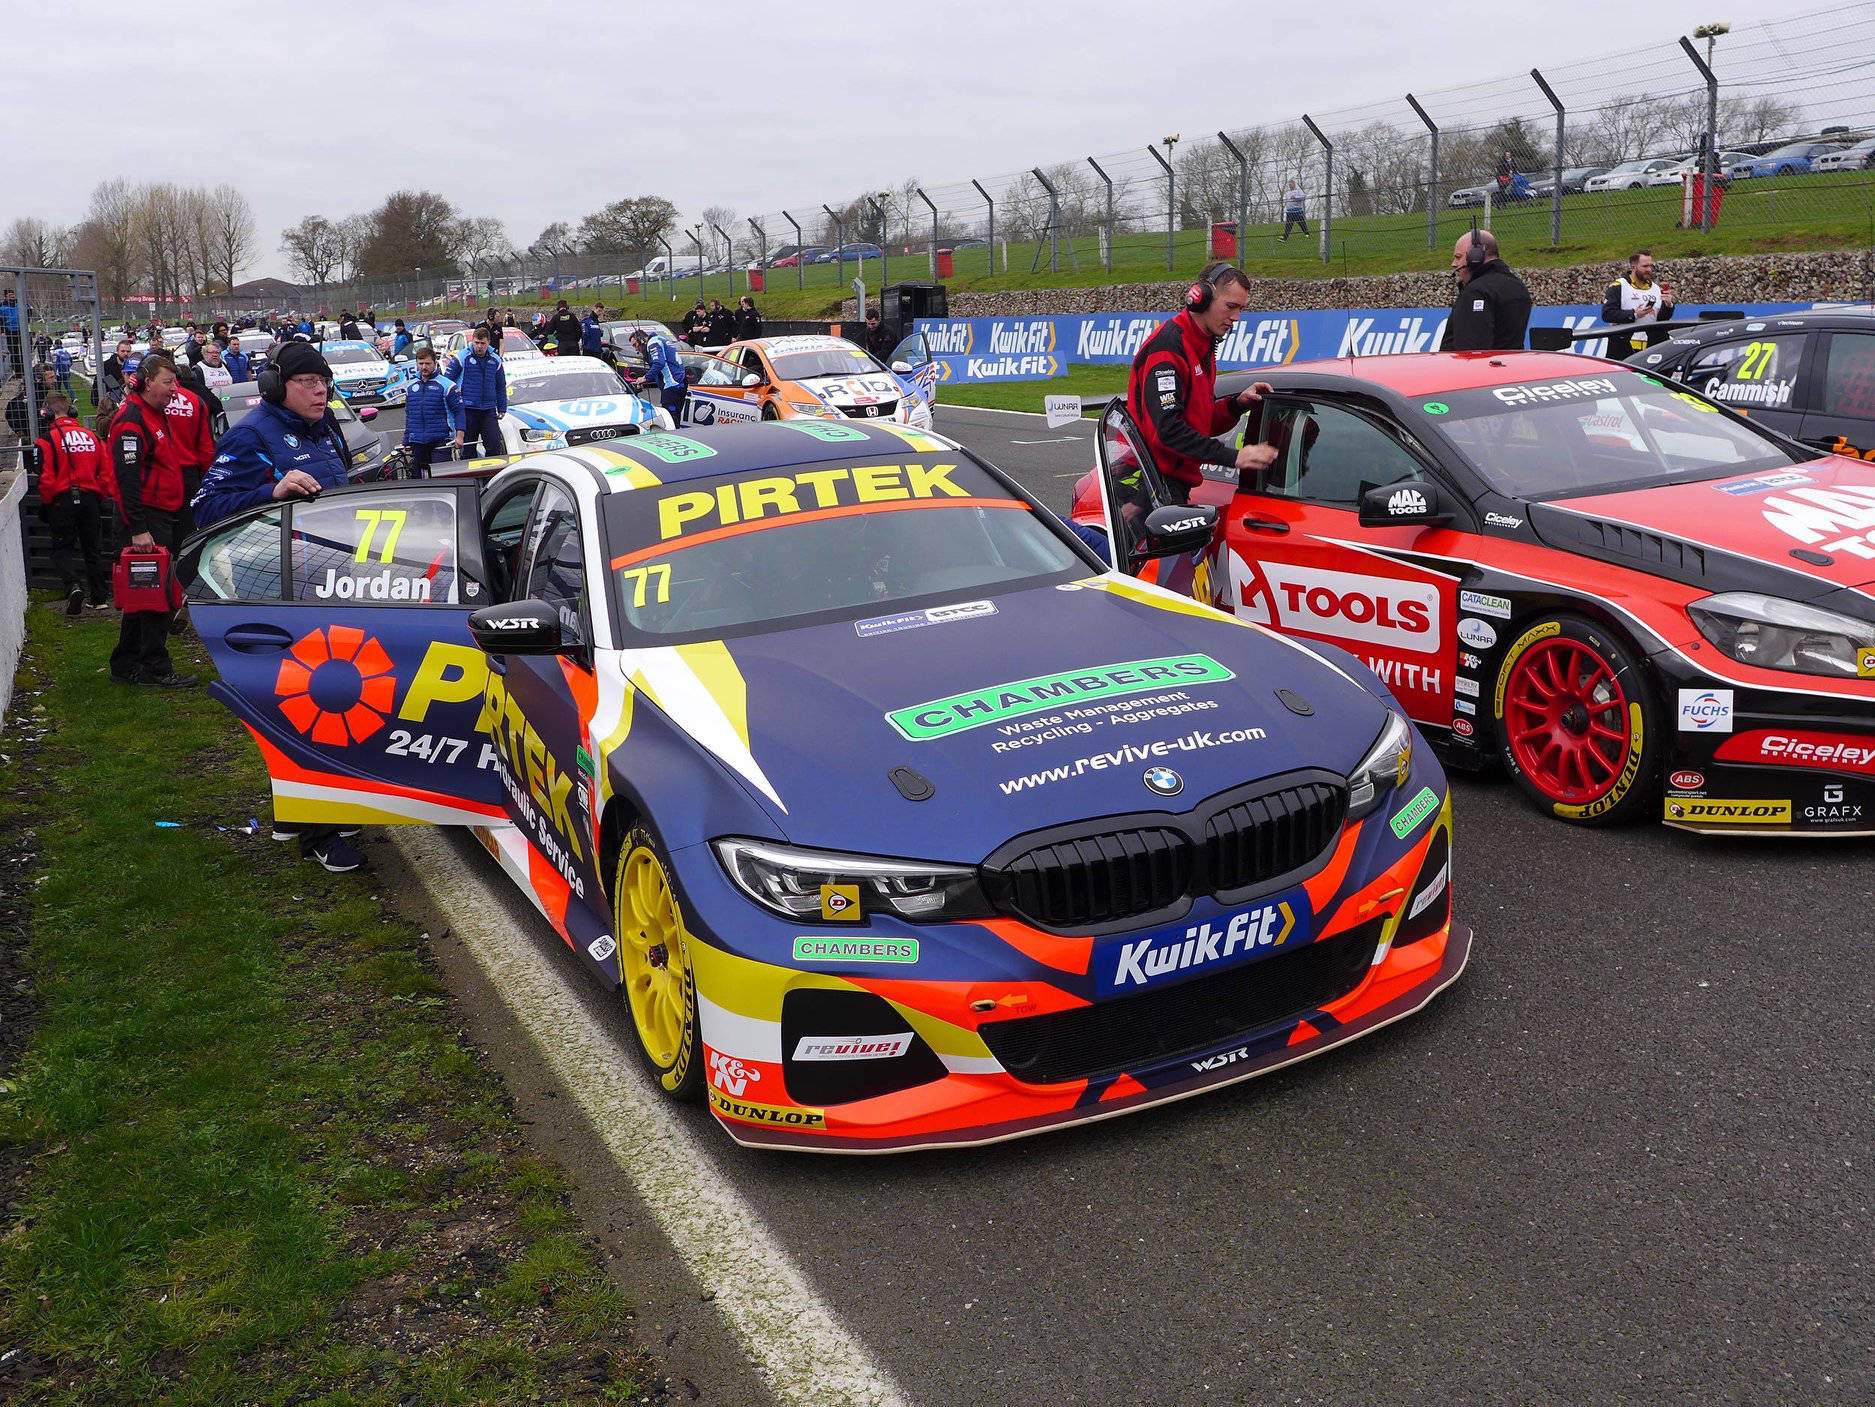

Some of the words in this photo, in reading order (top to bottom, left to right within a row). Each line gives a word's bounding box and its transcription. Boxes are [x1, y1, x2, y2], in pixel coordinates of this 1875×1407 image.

[1737, 342, 1776, 380] 27
[1492, 377, 1618, 400] Ciceley
[1705, 377, 1792, 403] Cammish
[164, 408, 193, 416] OOLS
[717, 408, 758, 422] Insuranc
[658, 464, 971, 539] PIRTEK
[1388, 489, 1426, 507] MAC
[1388, 505, 1427, 515] TOOLS
[1484, 512, 1523, 528] Ciceley
[1161, 516, 1207, 533] WSR
[355, 510, 407, 563] 77
[315, 569, 431, 599] Jordan
[624, 563, 672, 607] 77
[1280, 582, 1430, 633] TOOLS
[1462, 592, 1510, 610] CATACLEAN
[486, 617, 540, 629] WSR
[1460, 632, 1493, 644] LUNAR
[1369, 656, 1440, 694] WITH
[914, 661, 1210, 728] CHAMBERS
[998, 715, 1062, 736] Waste
[1064, 690, 1190, 721] Management
[1682, 705, 1729, 716] FUCHS
[991, 722, 1093, 754] Recycling
[1110, 699, 1218, 726] Aggregates
[1456, 721, 1471, 733] ABS
[999, 727, 1267, 795] www.revive-uk.com
[1761, 736, 1875, 764] Ciceley
[1761, 749, 1858, 765] MOTORSPORT
[1579, 751, 1640, 817] DUNLOP
[1675, 774, 1700, 784] ABS
[385, 730, 468, 764] 24/7
[538, 816, 584, 900] Service
[1396, 792, 1435, 832] CHAMBERS
[1689, 804, 1787, 817] DUNLOP
[1804, 805, 1862, 817] GRAFX
[800, 942, 912, 957] CHAMBERS
[1014, 1003, 1038, 1014] TOW
[804, 1037, 902, 1056] revive!
[1190, 1046, 1249, 1073] WSR
[720, 1097, 823, 1125] DUNLOP
